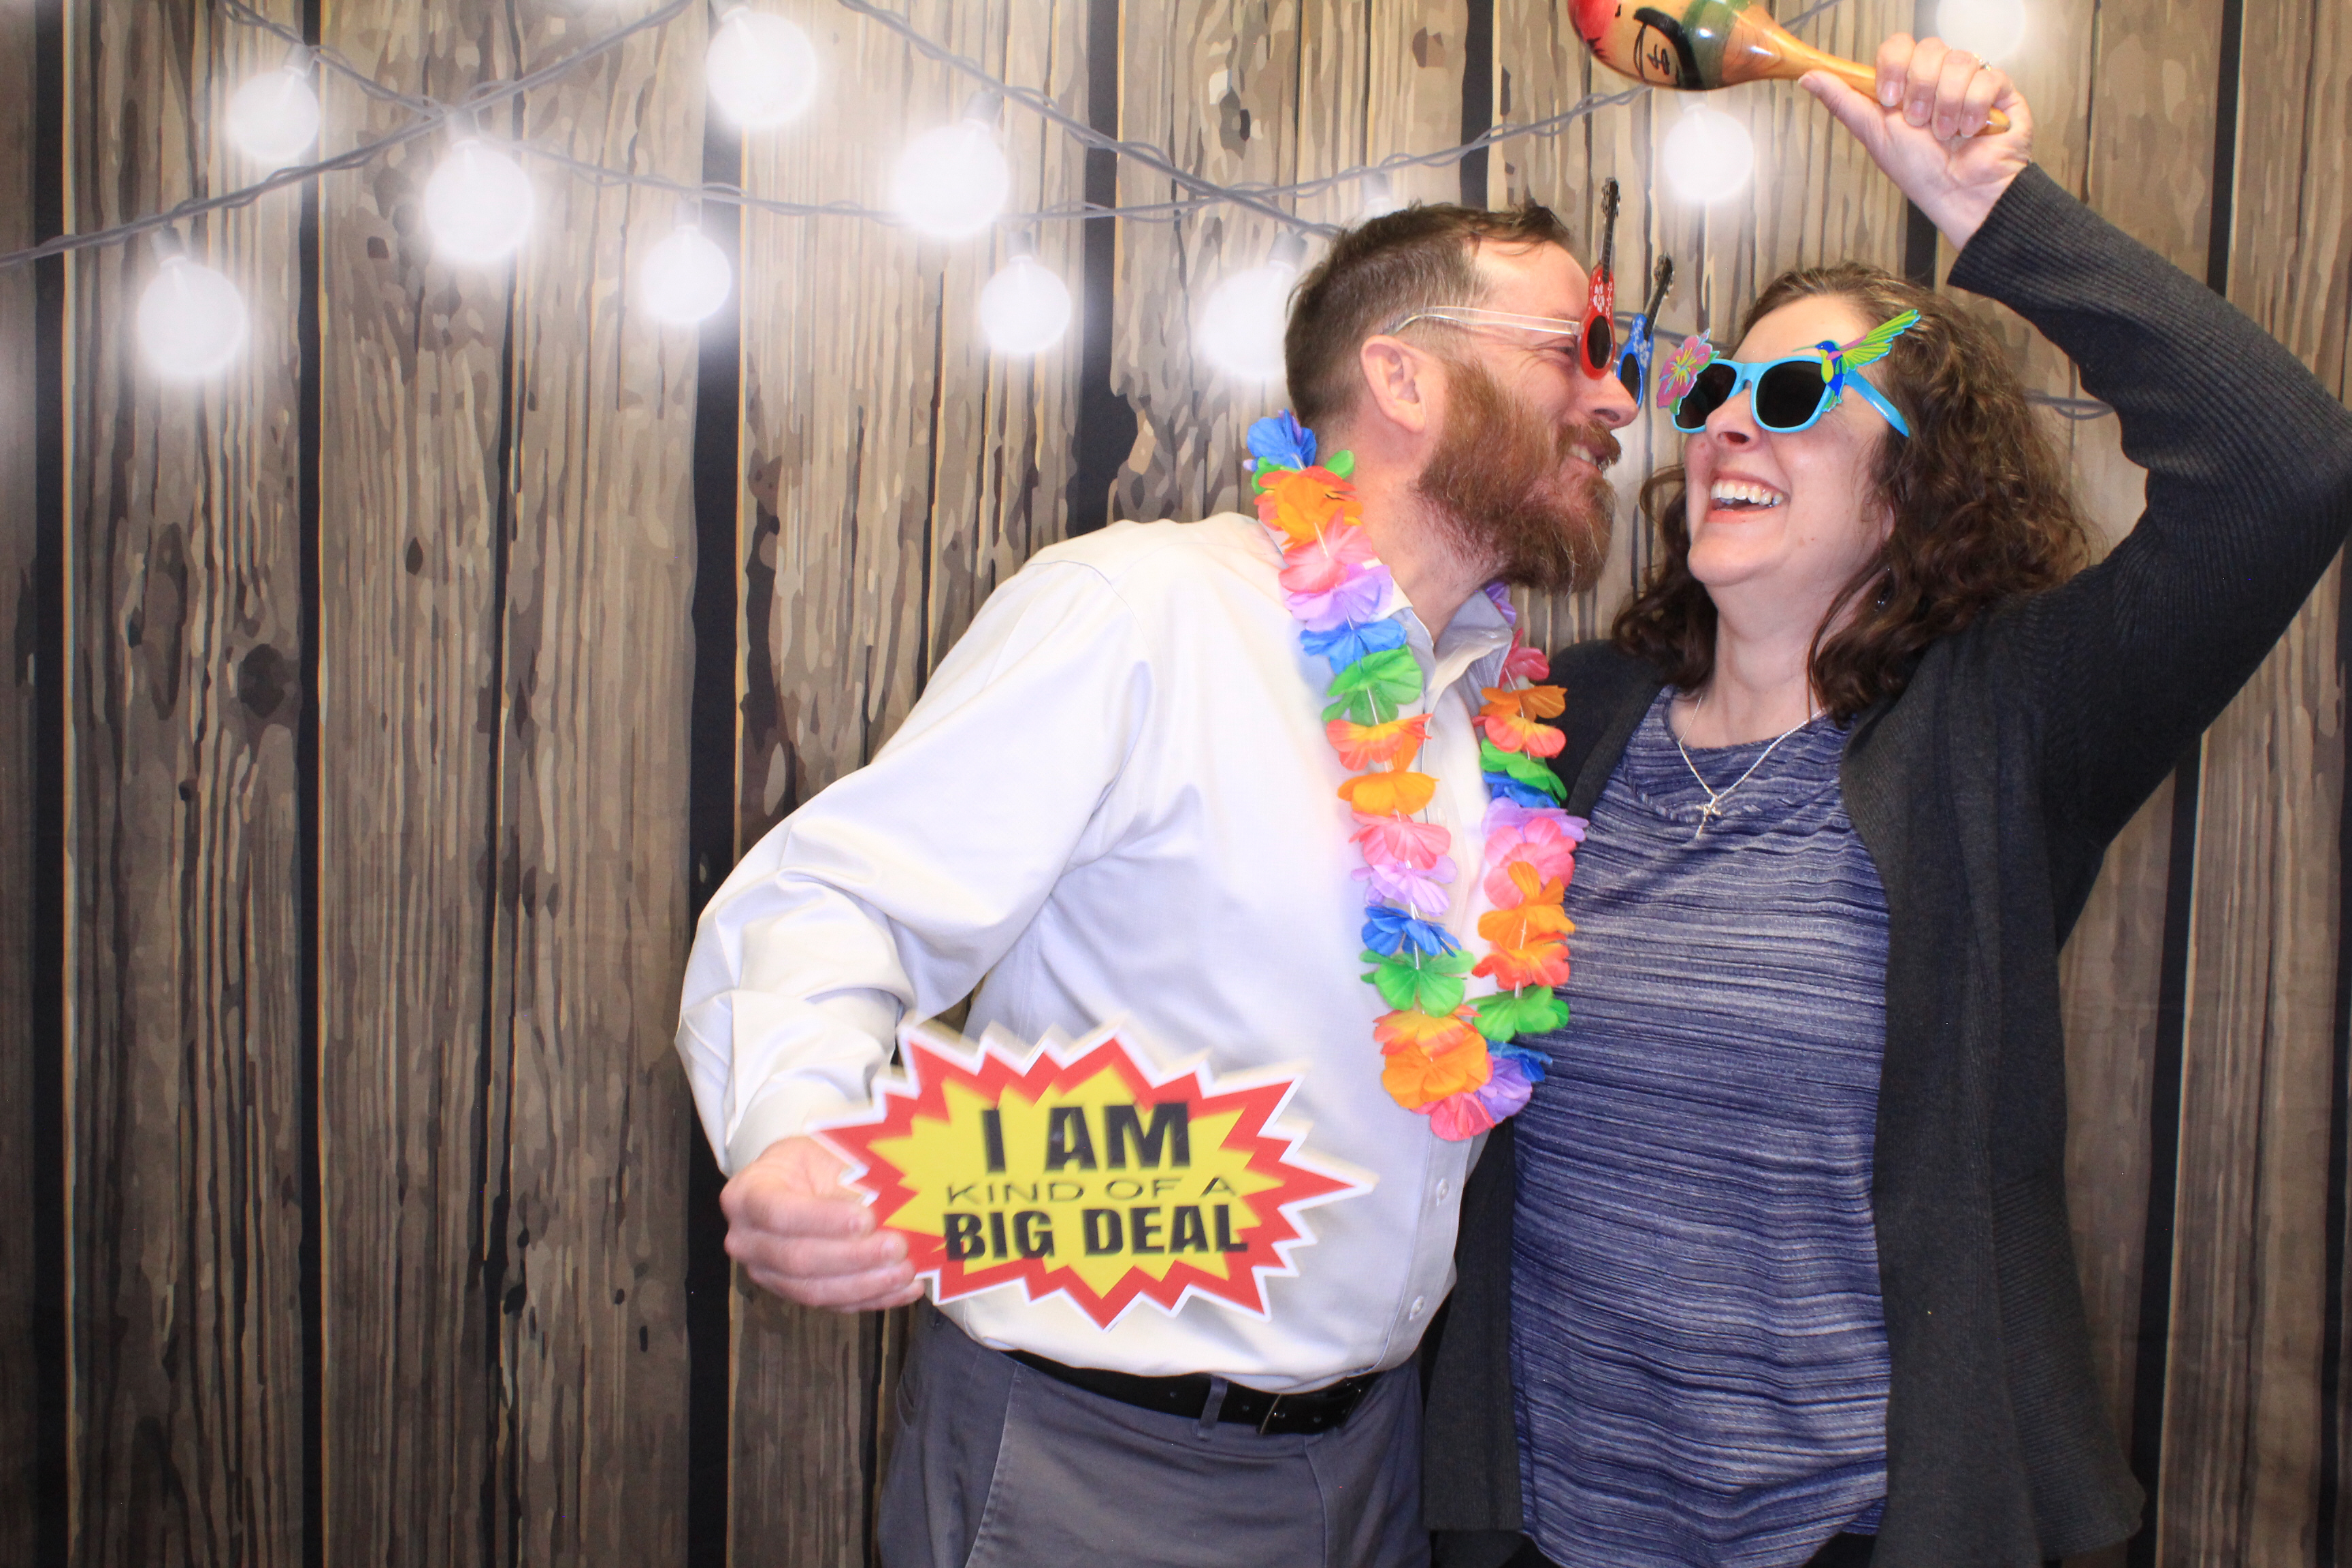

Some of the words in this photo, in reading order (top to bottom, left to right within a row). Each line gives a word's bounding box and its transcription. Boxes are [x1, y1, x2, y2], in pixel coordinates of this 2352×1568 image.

[981, 1108, 1006, 1174] I
[1043, 1101, 1191, 1172] AM
[947, 1181, 1084, 1204] KIND
[1105, 1178, 1183, 1199] OF
[1200, 1175, 1237, 1197] A
[943, 1210, 1055, 1260] BIG
[1082, 1205, 1248, 1255] DEAL
